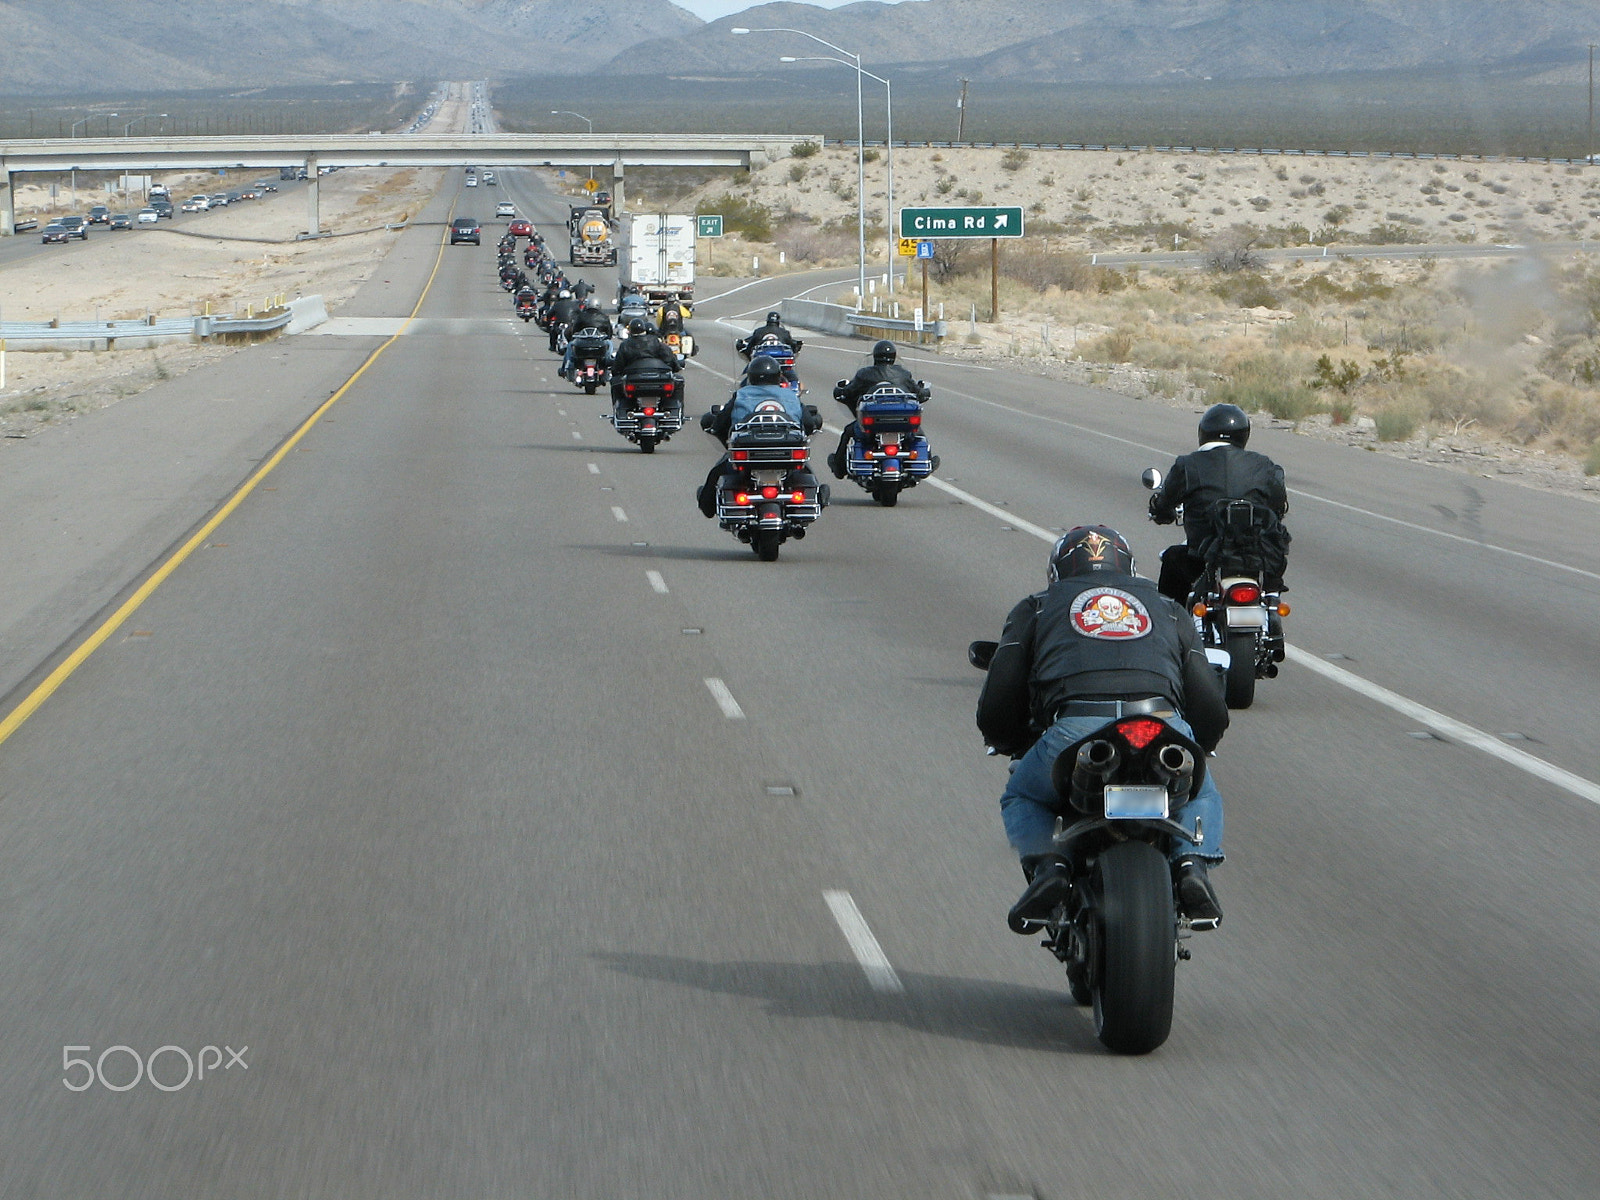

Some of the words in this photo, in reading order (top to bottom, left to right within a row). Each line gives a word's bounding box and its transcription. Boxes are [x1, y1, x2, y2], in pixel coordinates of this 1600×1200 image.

[914, 216, 956, 229] Cima
[964, 216, 985, 229] Rd
[901, 239, 917, 248] 45
